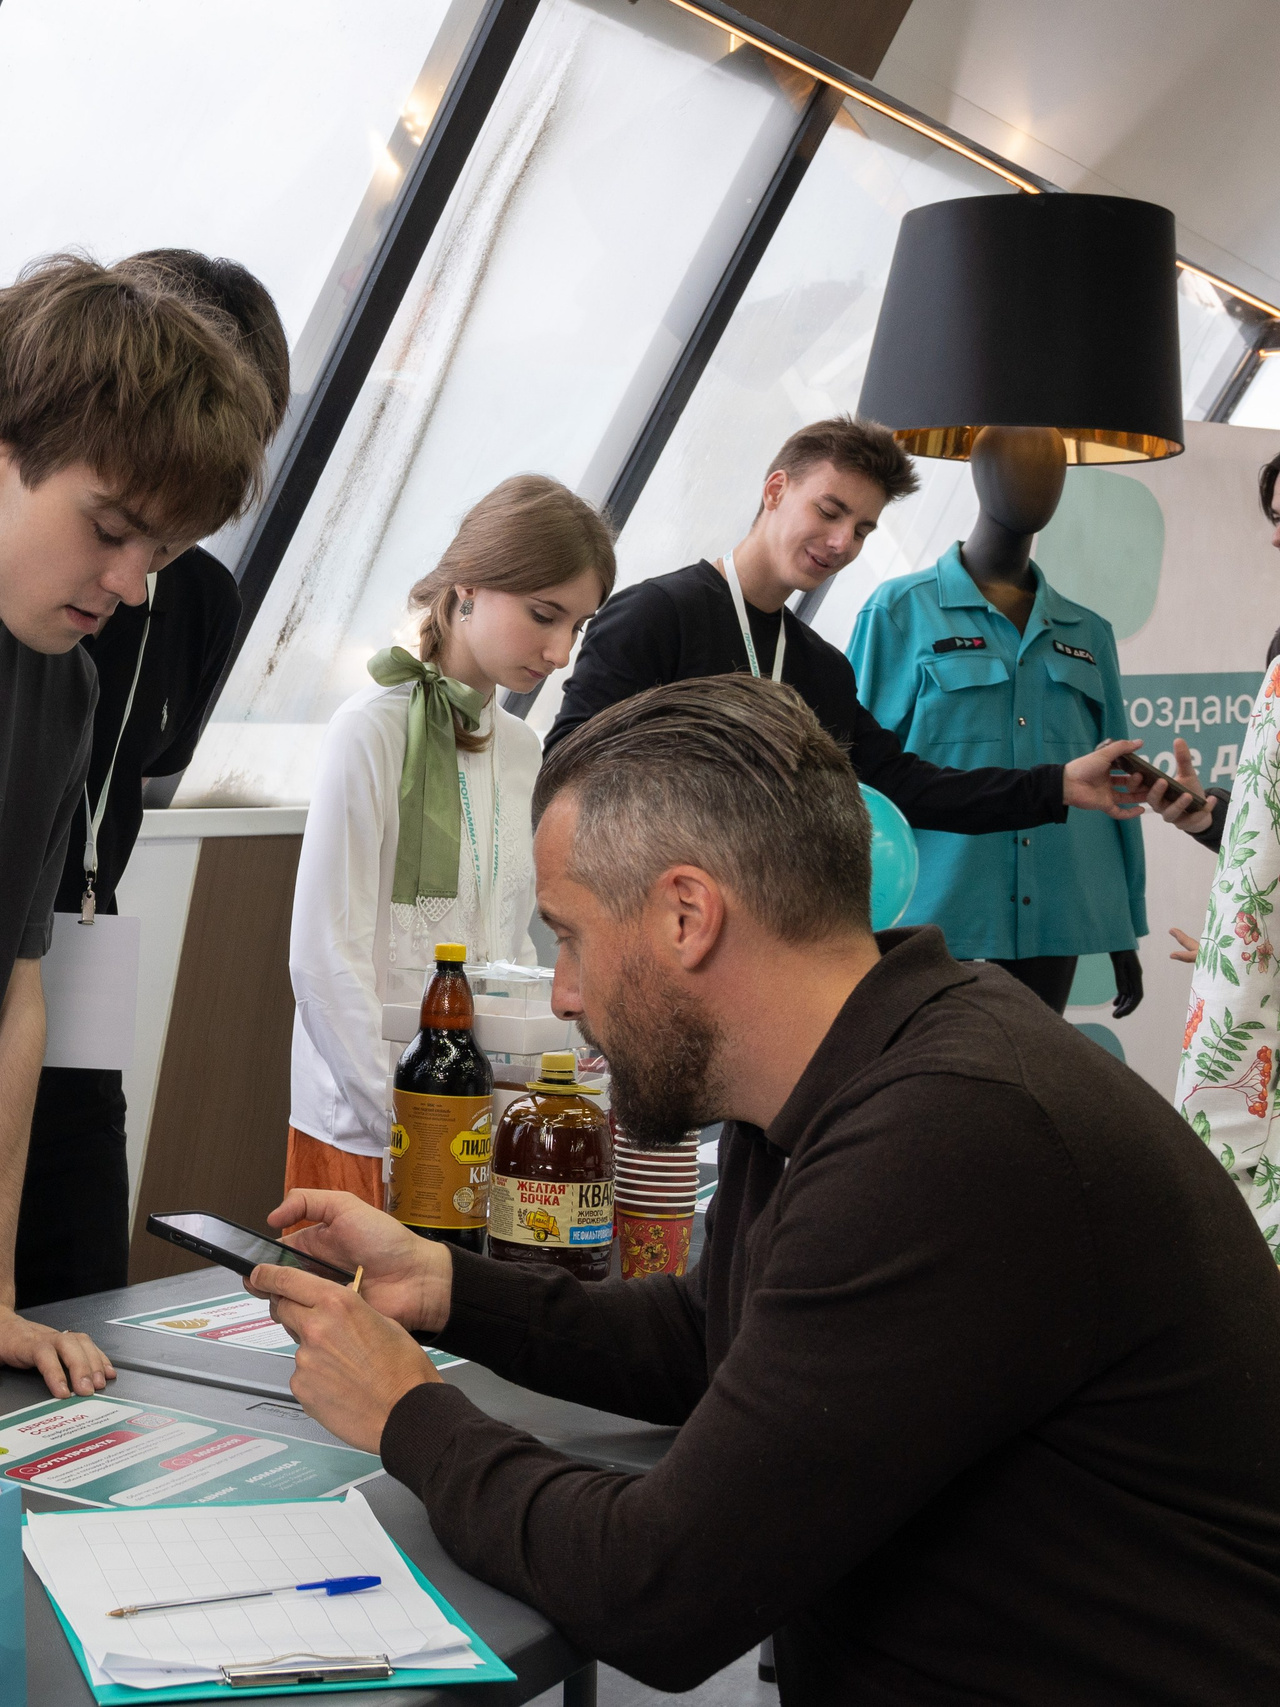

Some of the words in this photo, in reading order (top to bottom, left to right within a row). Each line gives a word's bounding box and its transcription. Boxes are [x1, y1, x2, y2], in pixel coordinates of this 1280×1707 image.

[744, 632, 759, 678] ПРОГРАММ
[1123, 694, 1256, 734] оздаю
[458, 771, 477, 845] ПРОГРАММА
[469, 1165, 490, 1184] КВ
[517, 1180, 567, 1195] ЖЕЛТАЯ
[520, 1193, 560, 1206] БОЧКА
[17, 1415, 64, 1433] ДЕРЕВО
[30, 1413, 89, 1436] СОБЫТИЙ
[37, 1454, 68, 1469] СУТЬ
[66, 1439, 117, 1459] ПРОЕКТА
[245, 1460, 302, 1483] КОМАНДА
